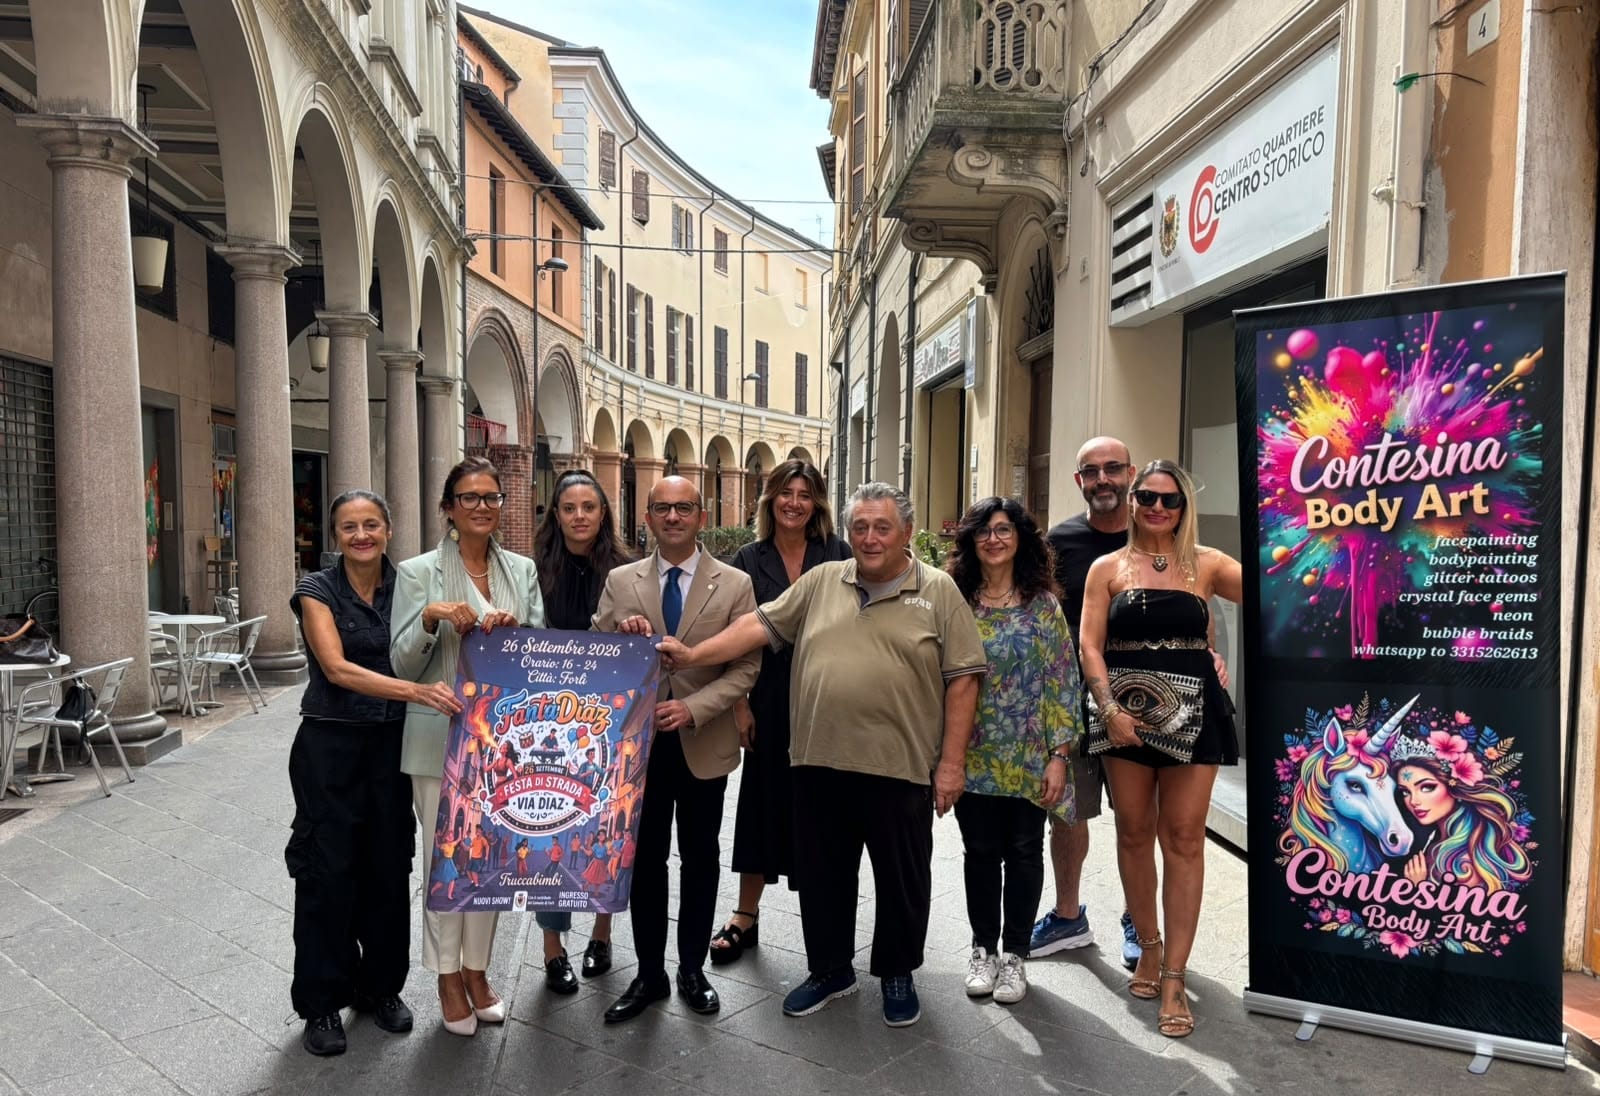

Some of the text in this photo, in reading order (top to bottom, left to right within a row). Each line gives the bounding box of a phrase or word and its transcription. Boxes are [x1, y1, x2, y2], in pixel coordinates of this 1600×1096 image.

[1478, 12, 1486, 38] 4
[1215, 105, 1325, 189] COMITATO QUARTIERE
[1214, 130, 1325, 214] CENTRO STORICO
[1290, 431, 1508, 494] Contesina
[1305, 482, 1489, 532] Body Art
[1433, 533, 1539, 550] facepainting
[1429, 552, 1539, 568] bodypainting
[1423, 572, 1537, 587] glitter tattoos
[1399, 590, 1537, 606] crystal face gems
[1492, 611, 1533, 622] neon
[1422, 627, 1534, 641] bubble braids
[501, 636, 621, 657] 26 Settembre 2026
[1353, 644, 1538, 660] whatsapp to 3315262613
[520, 655, 559, 669] Orario:
[562, 659, 573, 669] 16
[583, 660, 597, 671] 24
[527, 669, 556, 684] Città:
[495, 690, 612, 734] FantaDiaz
[524, 766, 534, 775] 26
[503, 776, 583, 798] FESTA DI STRADA
[517, 797, 565, 810] VIA DIAZ
[499, 871, 563, 887] Truccabimbi
[1285, 847, 1528, 921] Contesina
[473, 896, 511, 905] NUOVI SHOW!
[559, 891, 589, 900] INGRESSO
[558, 900, 588, 908] GRATUITO
[1361, 904, 1497, 944] Body Art
